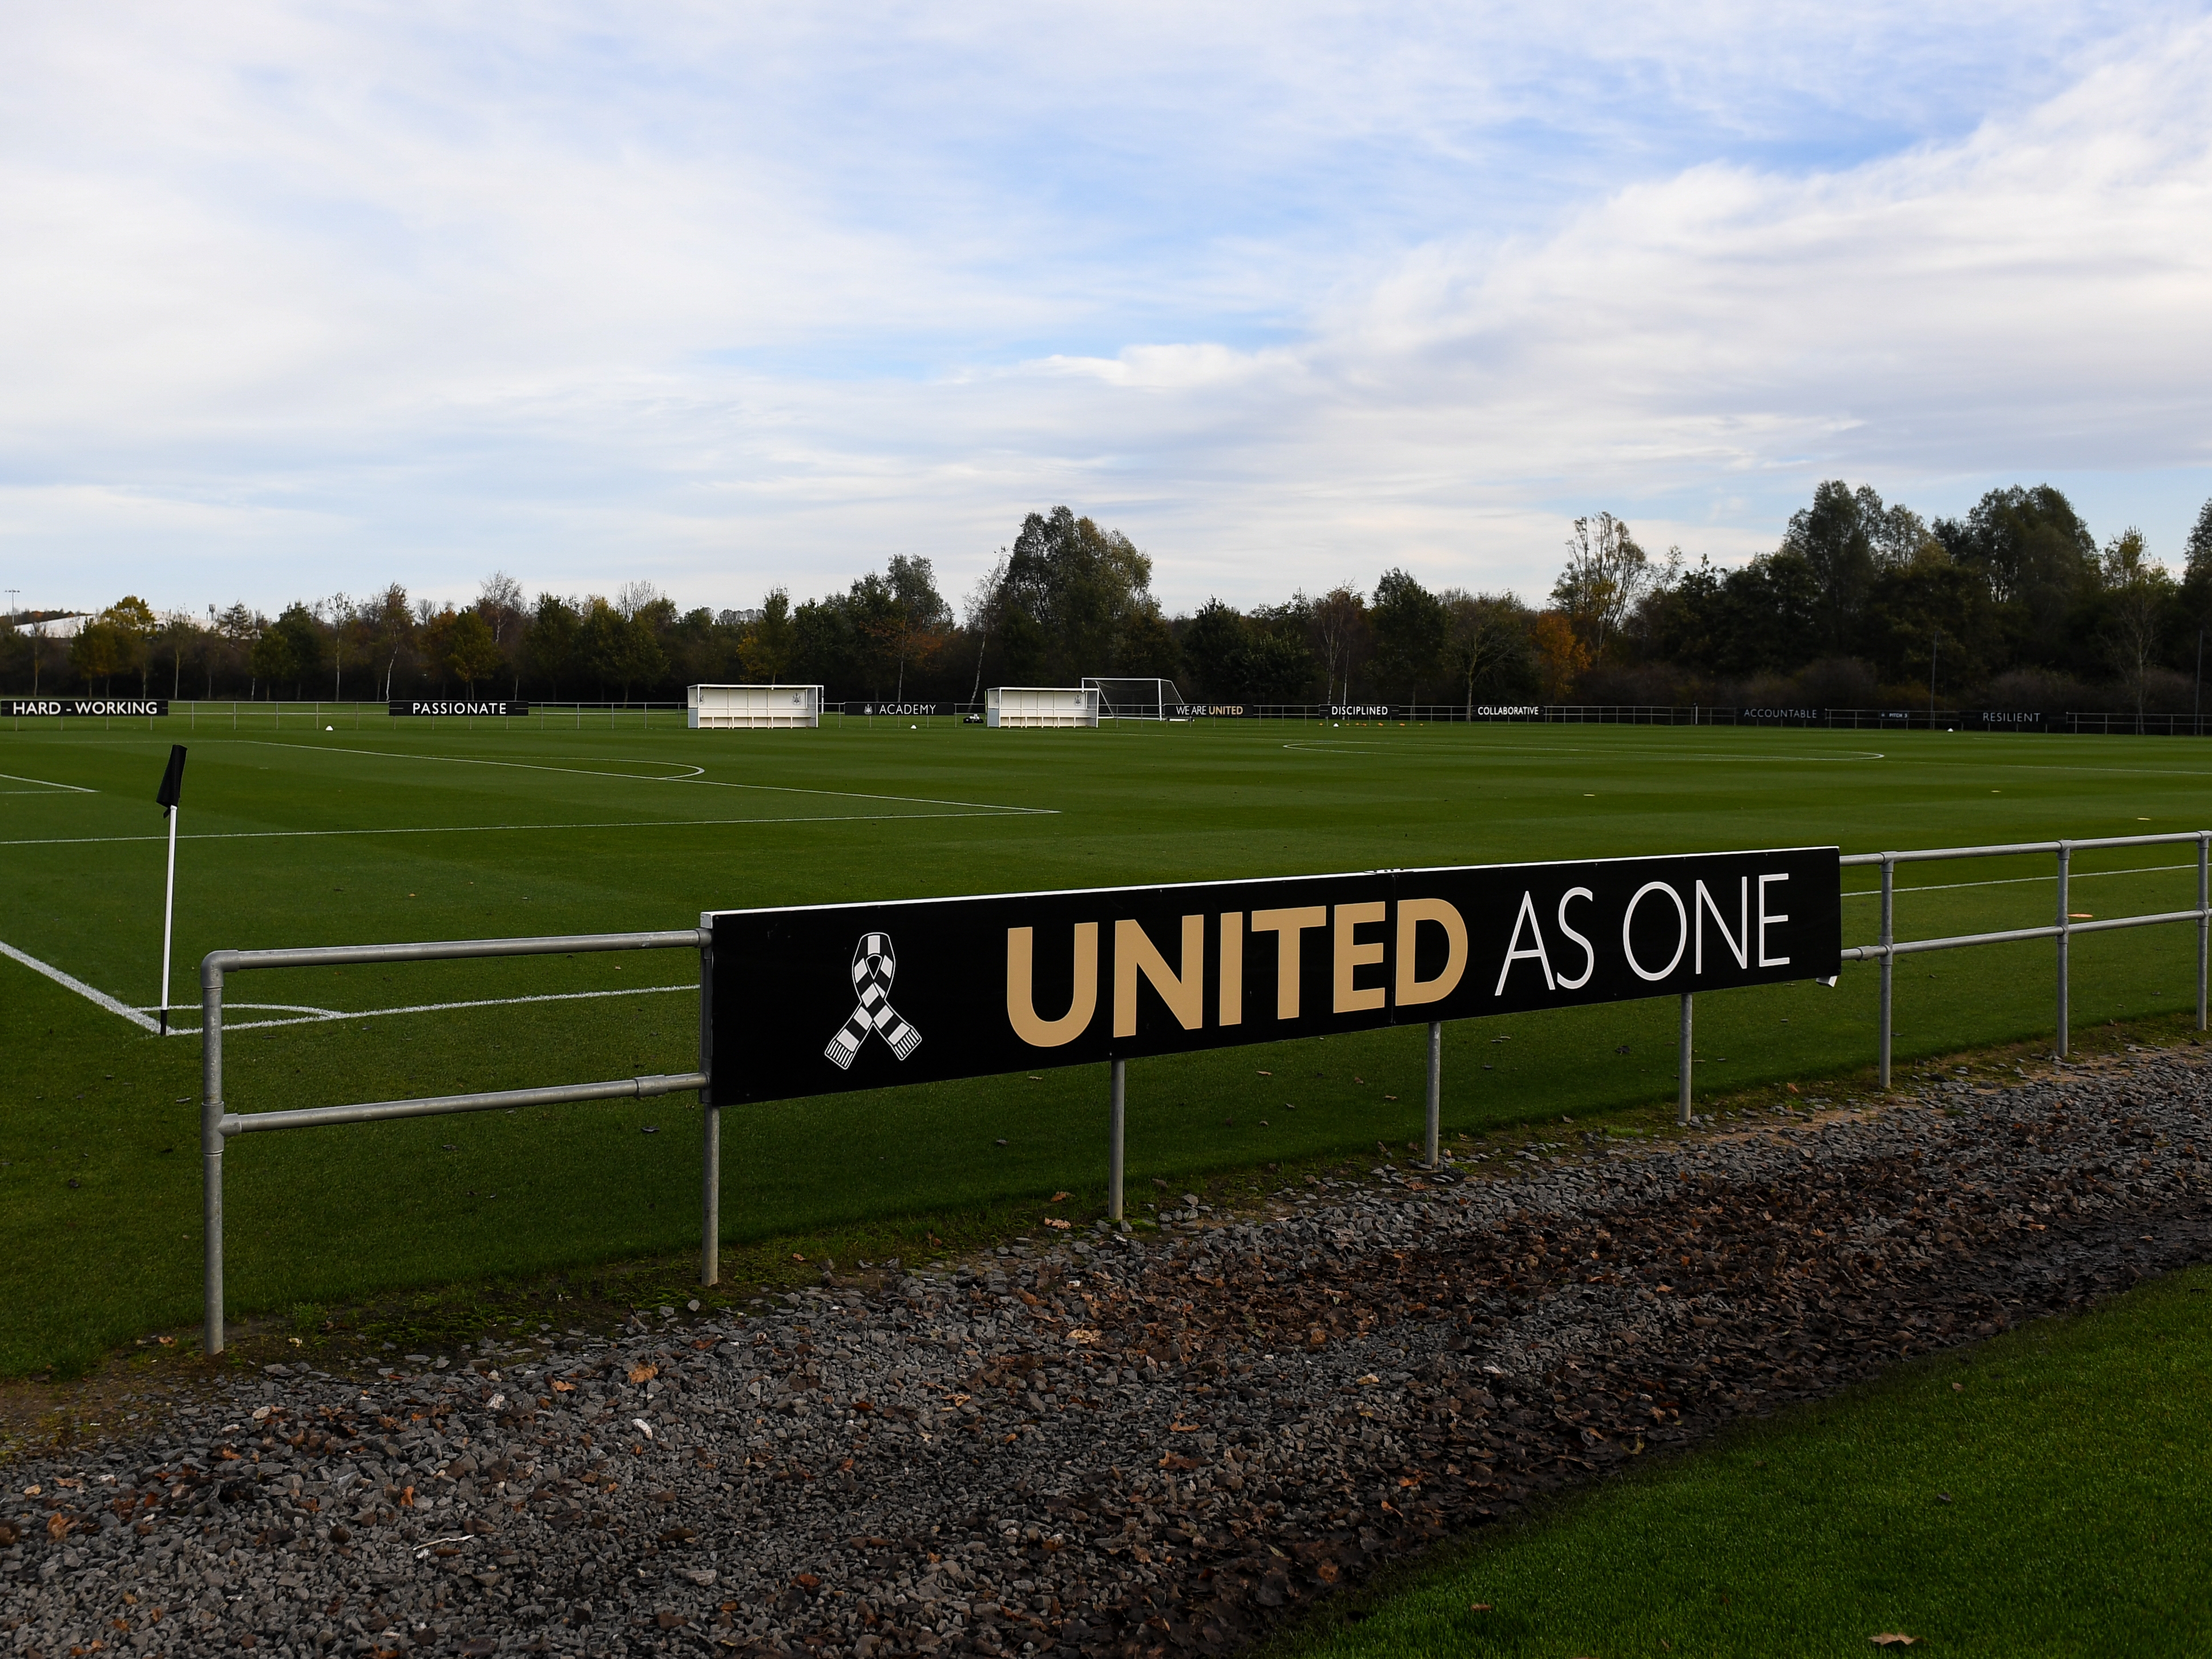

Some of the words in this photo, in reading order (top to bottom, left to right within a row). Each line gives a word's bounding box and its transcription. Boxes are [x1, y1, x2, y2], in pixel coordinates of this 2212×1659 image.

[13, 702, 61, 715] HARD
[75, 701, 158, 715] WORKING
[413, 703, 507, 715] PASSIONATE
[879, 704, 936, 715] ACADEMY
[1176, 705, 1189, 715] WE
[1191, 705, 1206, 715] ARE
[1209, 705, 1243, 715] UNITED
[1331, 706, 1388, 715] DISCIPLINED
[1478, 707, 1539, 716] COLLABORATIVE
[1744, 709, 1817, 719] ACCOUNTABLE
[1983, 712, 2041, 722] RESILIENT
[1006, 897, 1469, 1048] UNITED
[1494, 887, 1595, 996] AS
[1622, 873, 1791, 981] ONE
